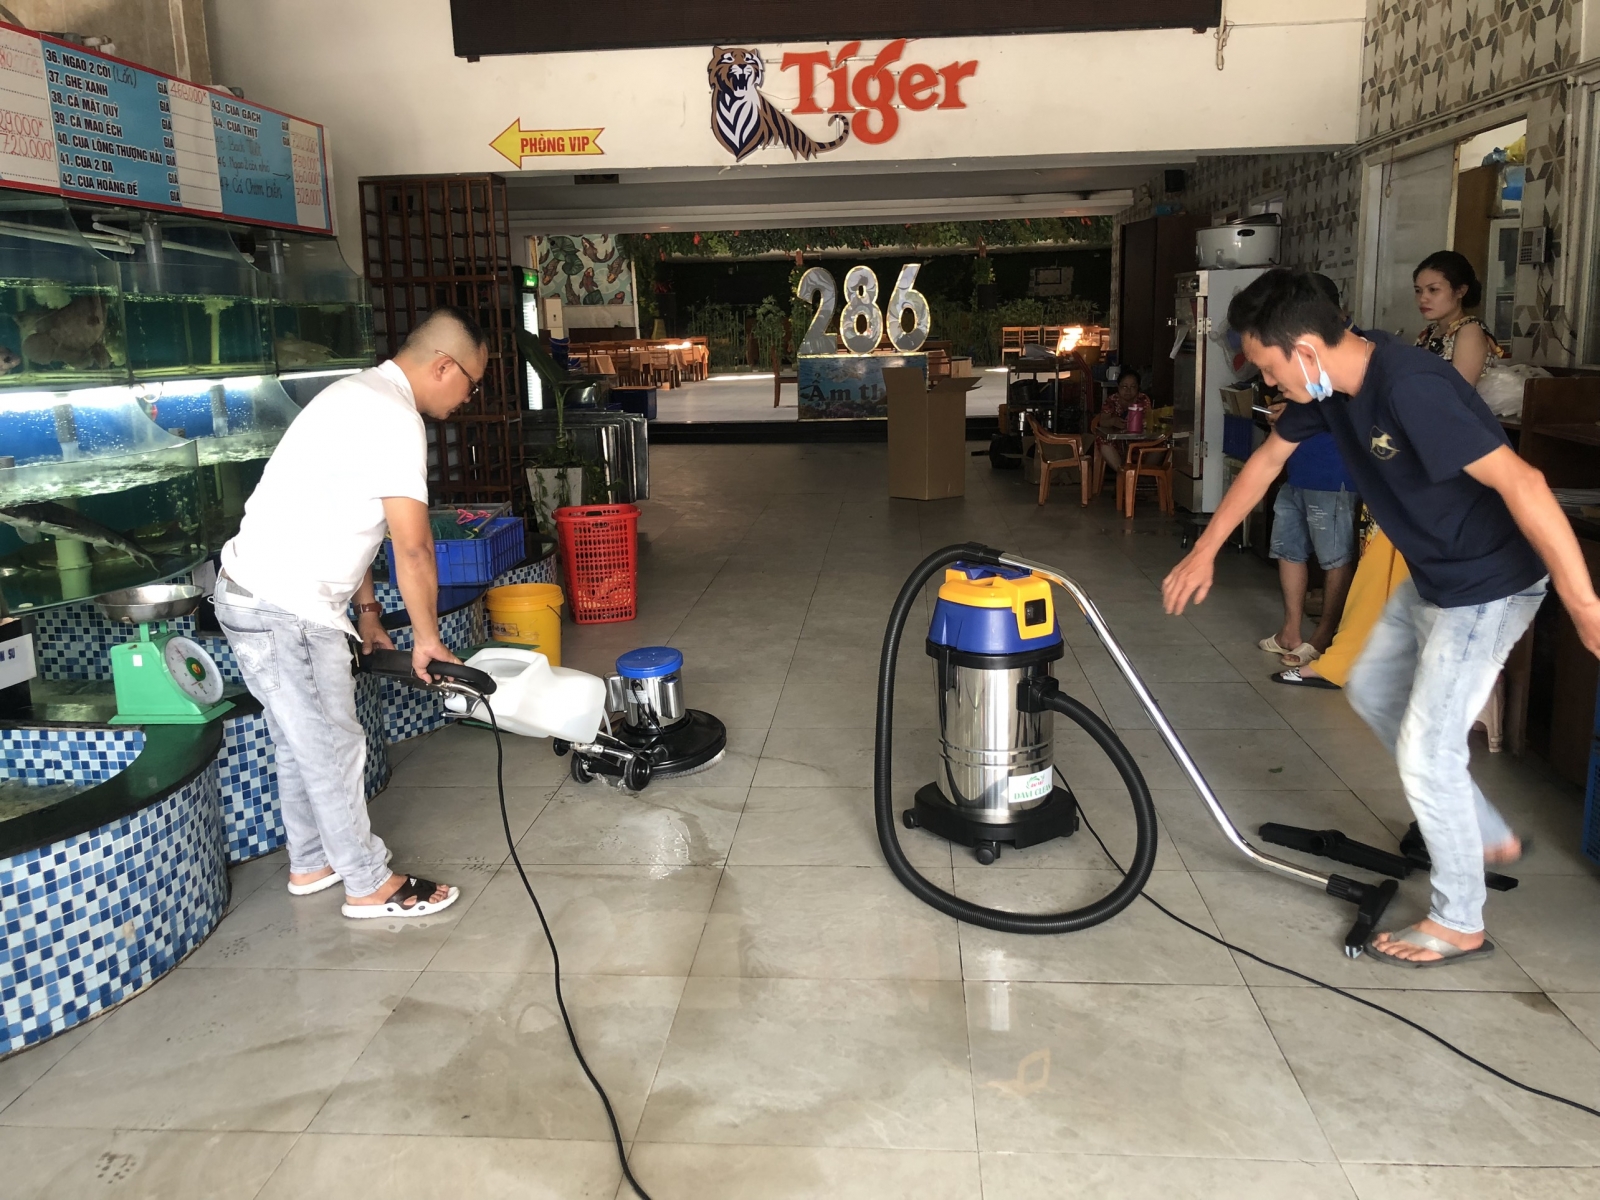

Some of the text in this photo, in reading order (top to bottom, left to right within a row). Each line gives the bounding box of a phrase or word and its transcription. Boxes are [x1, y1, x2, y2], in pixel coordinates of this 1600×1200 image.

[46, 50, 61, 64] 36.
[63, 54, 87, 72] NGAO
[89, 62, 95, 74] 2
[49, 70, 109, 97] 37. GHẸ XANH
[780, 38, 978, 144] Tiger
[51, 91, 66, 105] 38.
[68, 94, 80, 109] CÁ
[54, 112, 68, 126] 39.
[70, 114, 83, 129] CÁ
[84, 118, 104, 133] MAO
[211, 100, 261, 124] 43. CUA GẠCH
[213, 117, 258, 140] 44. CUA THỊT
[57, 132, 71, 146] 40.
[73, 135, 89, 151] CUA
[92, 138, 115, 155] LÔNG
[116, 144, 148, 163] THƯỢNG
[521, 134, 590, 153] PHÒNG VIP
[60, 153, 114, 174] 41. CUA 2 DA
[63, 173, 76, 186] 42.
[78, 176, 95, 191] CUA
[97, 178, 126, 193] HOÀNG
[797, 263, 931, 354] 286
